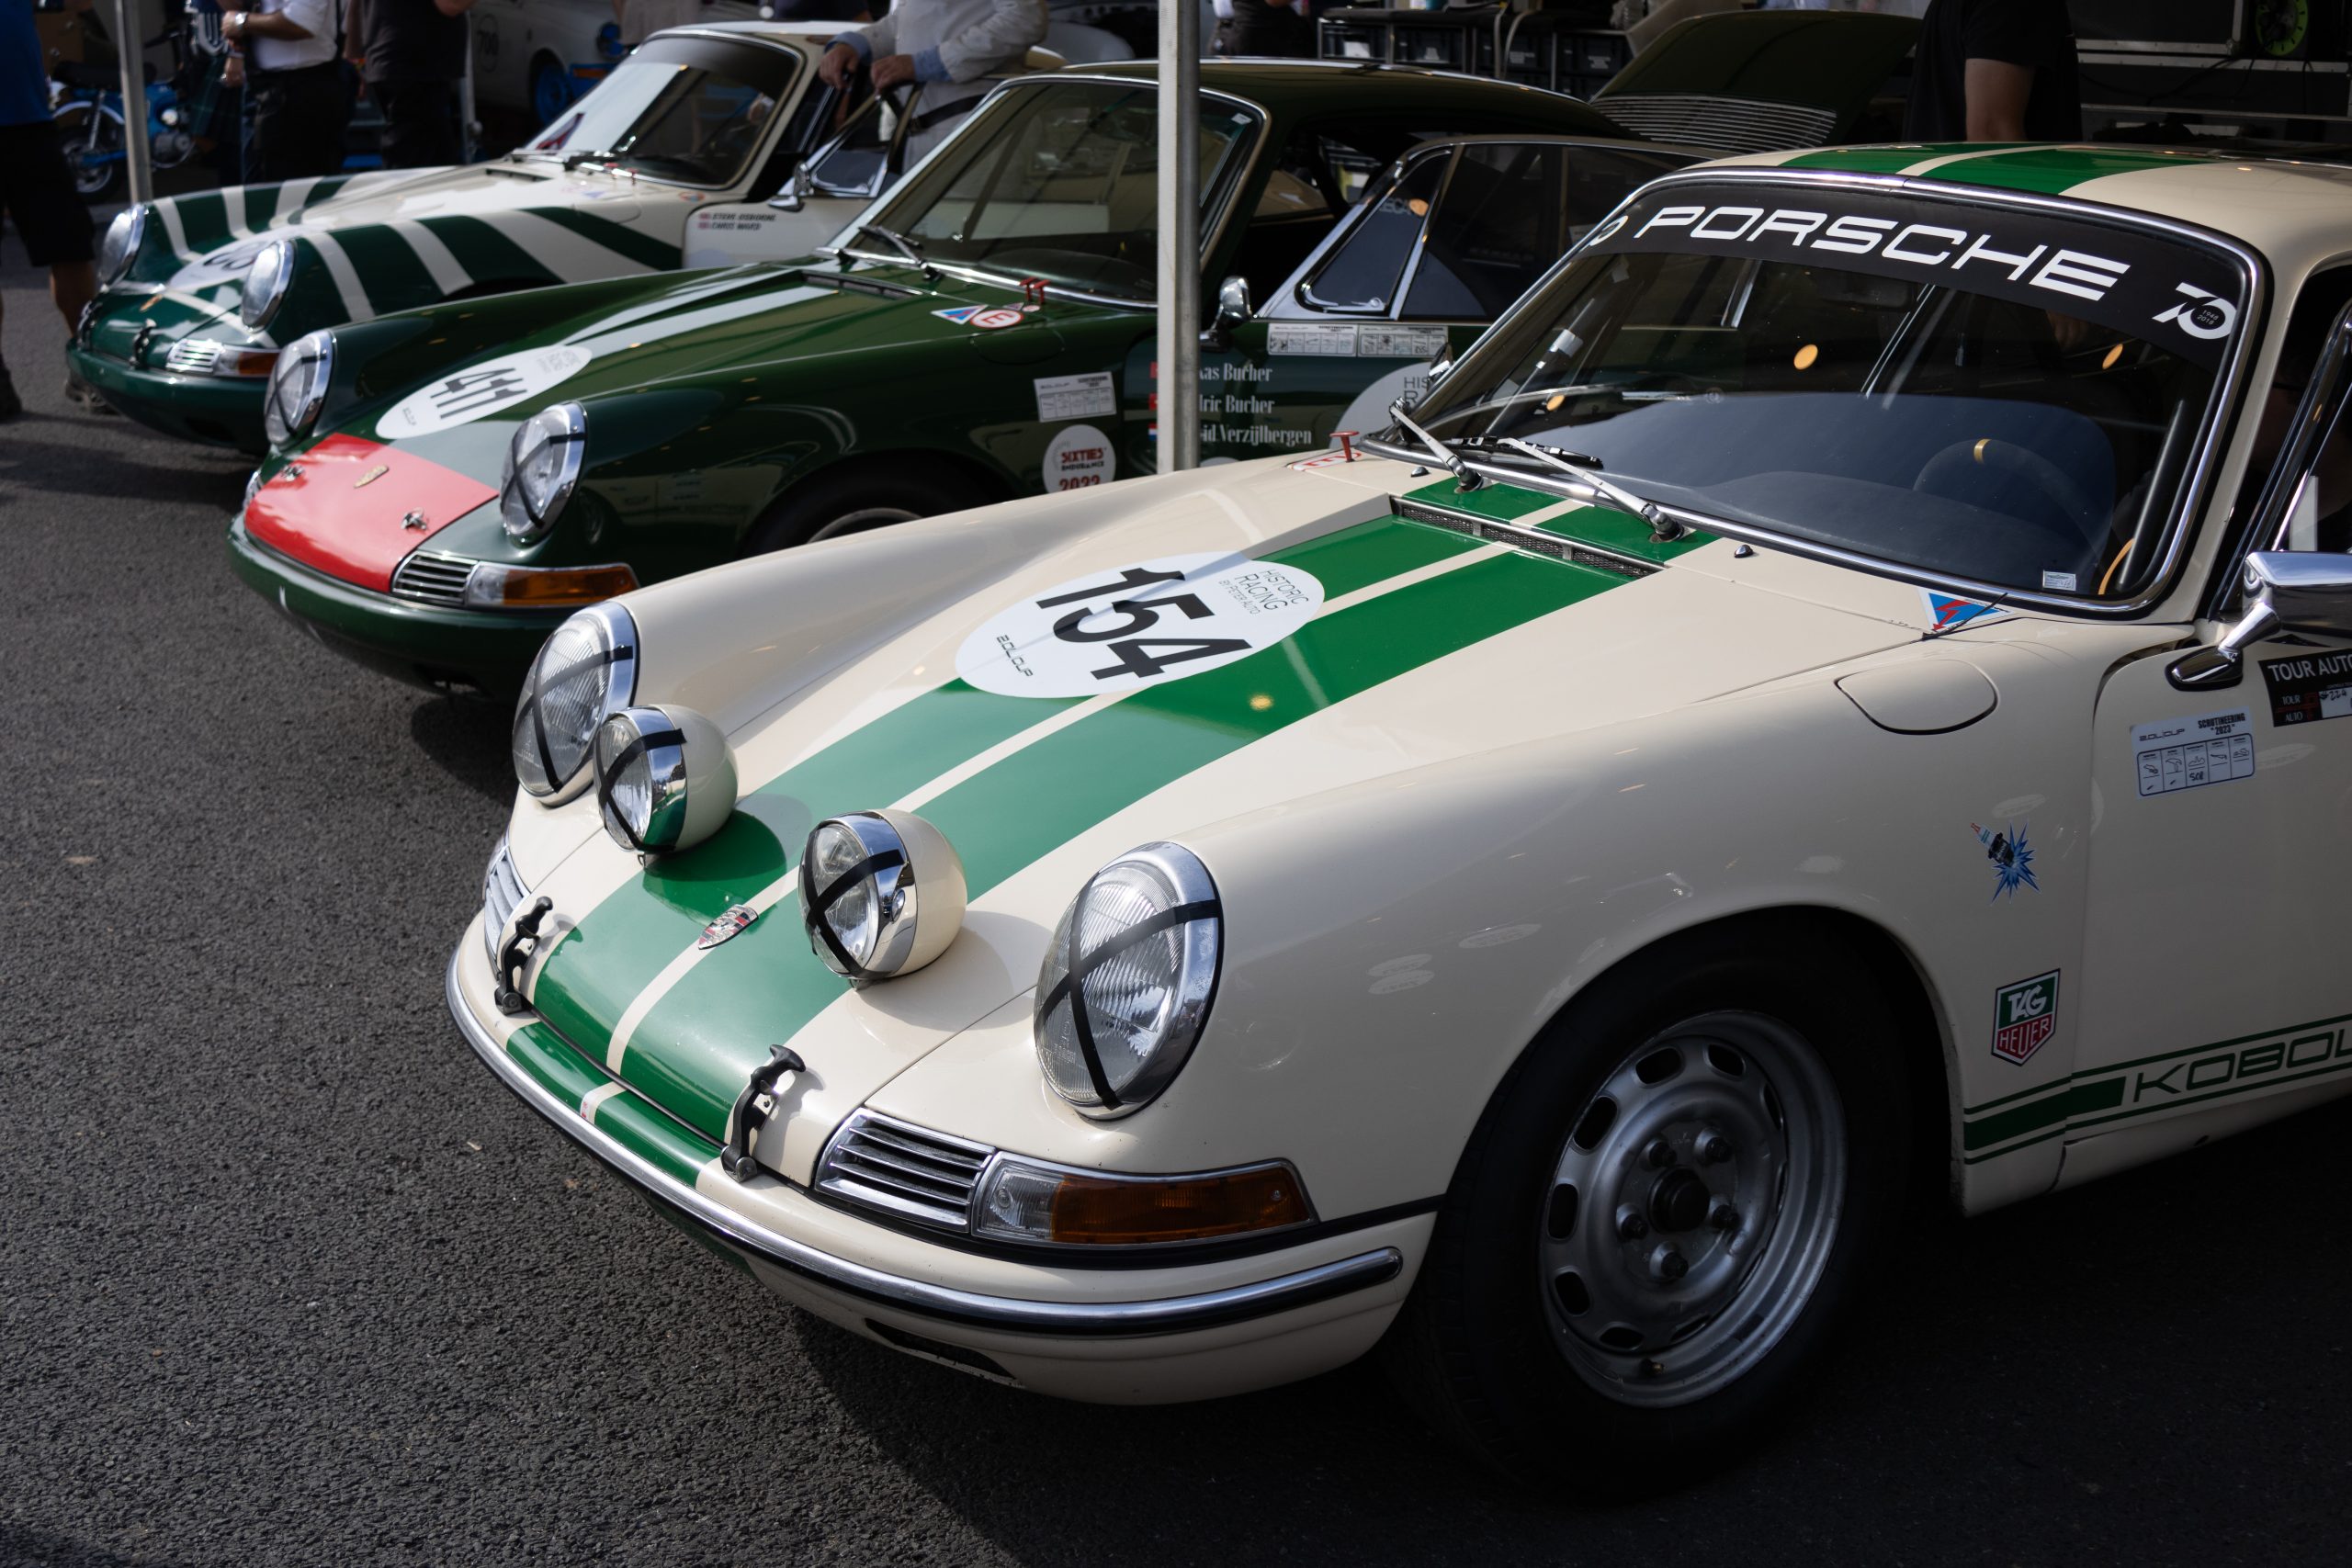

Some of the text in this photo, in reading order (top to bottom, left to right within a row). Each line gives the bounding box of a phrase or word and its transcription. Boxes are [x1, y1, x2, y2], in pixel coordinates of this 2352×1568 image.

[1633, 206, 2131, 301] PORSCHE
[2151, 282, 2236, 340] 70
[2197, 314, 2215, 326] 2018
[1224, 363, 1273, 381] Bucher
[430, 367, 527, 420] 411
[1226, 394, 1276, 413] Bucher
[1220, 424, 1312, 447] Verzijlbergen
[1234, 573, 1288, 610] RACING
[1259, 569, 1309, 604] HISTORIC
[1036, 568, 1252, 680] 154
[2267, 660, 2316, 682] TOUR
[2282, 694, 2301, 705] TOUR
[2198, 713, 2245, 728] SCRUTINEERING
[2285, 711, 2304, 722] AUTO
[2008, 985, 2048, 1022] TAG
[1999, 1018, 2050, 1055] HEUER
